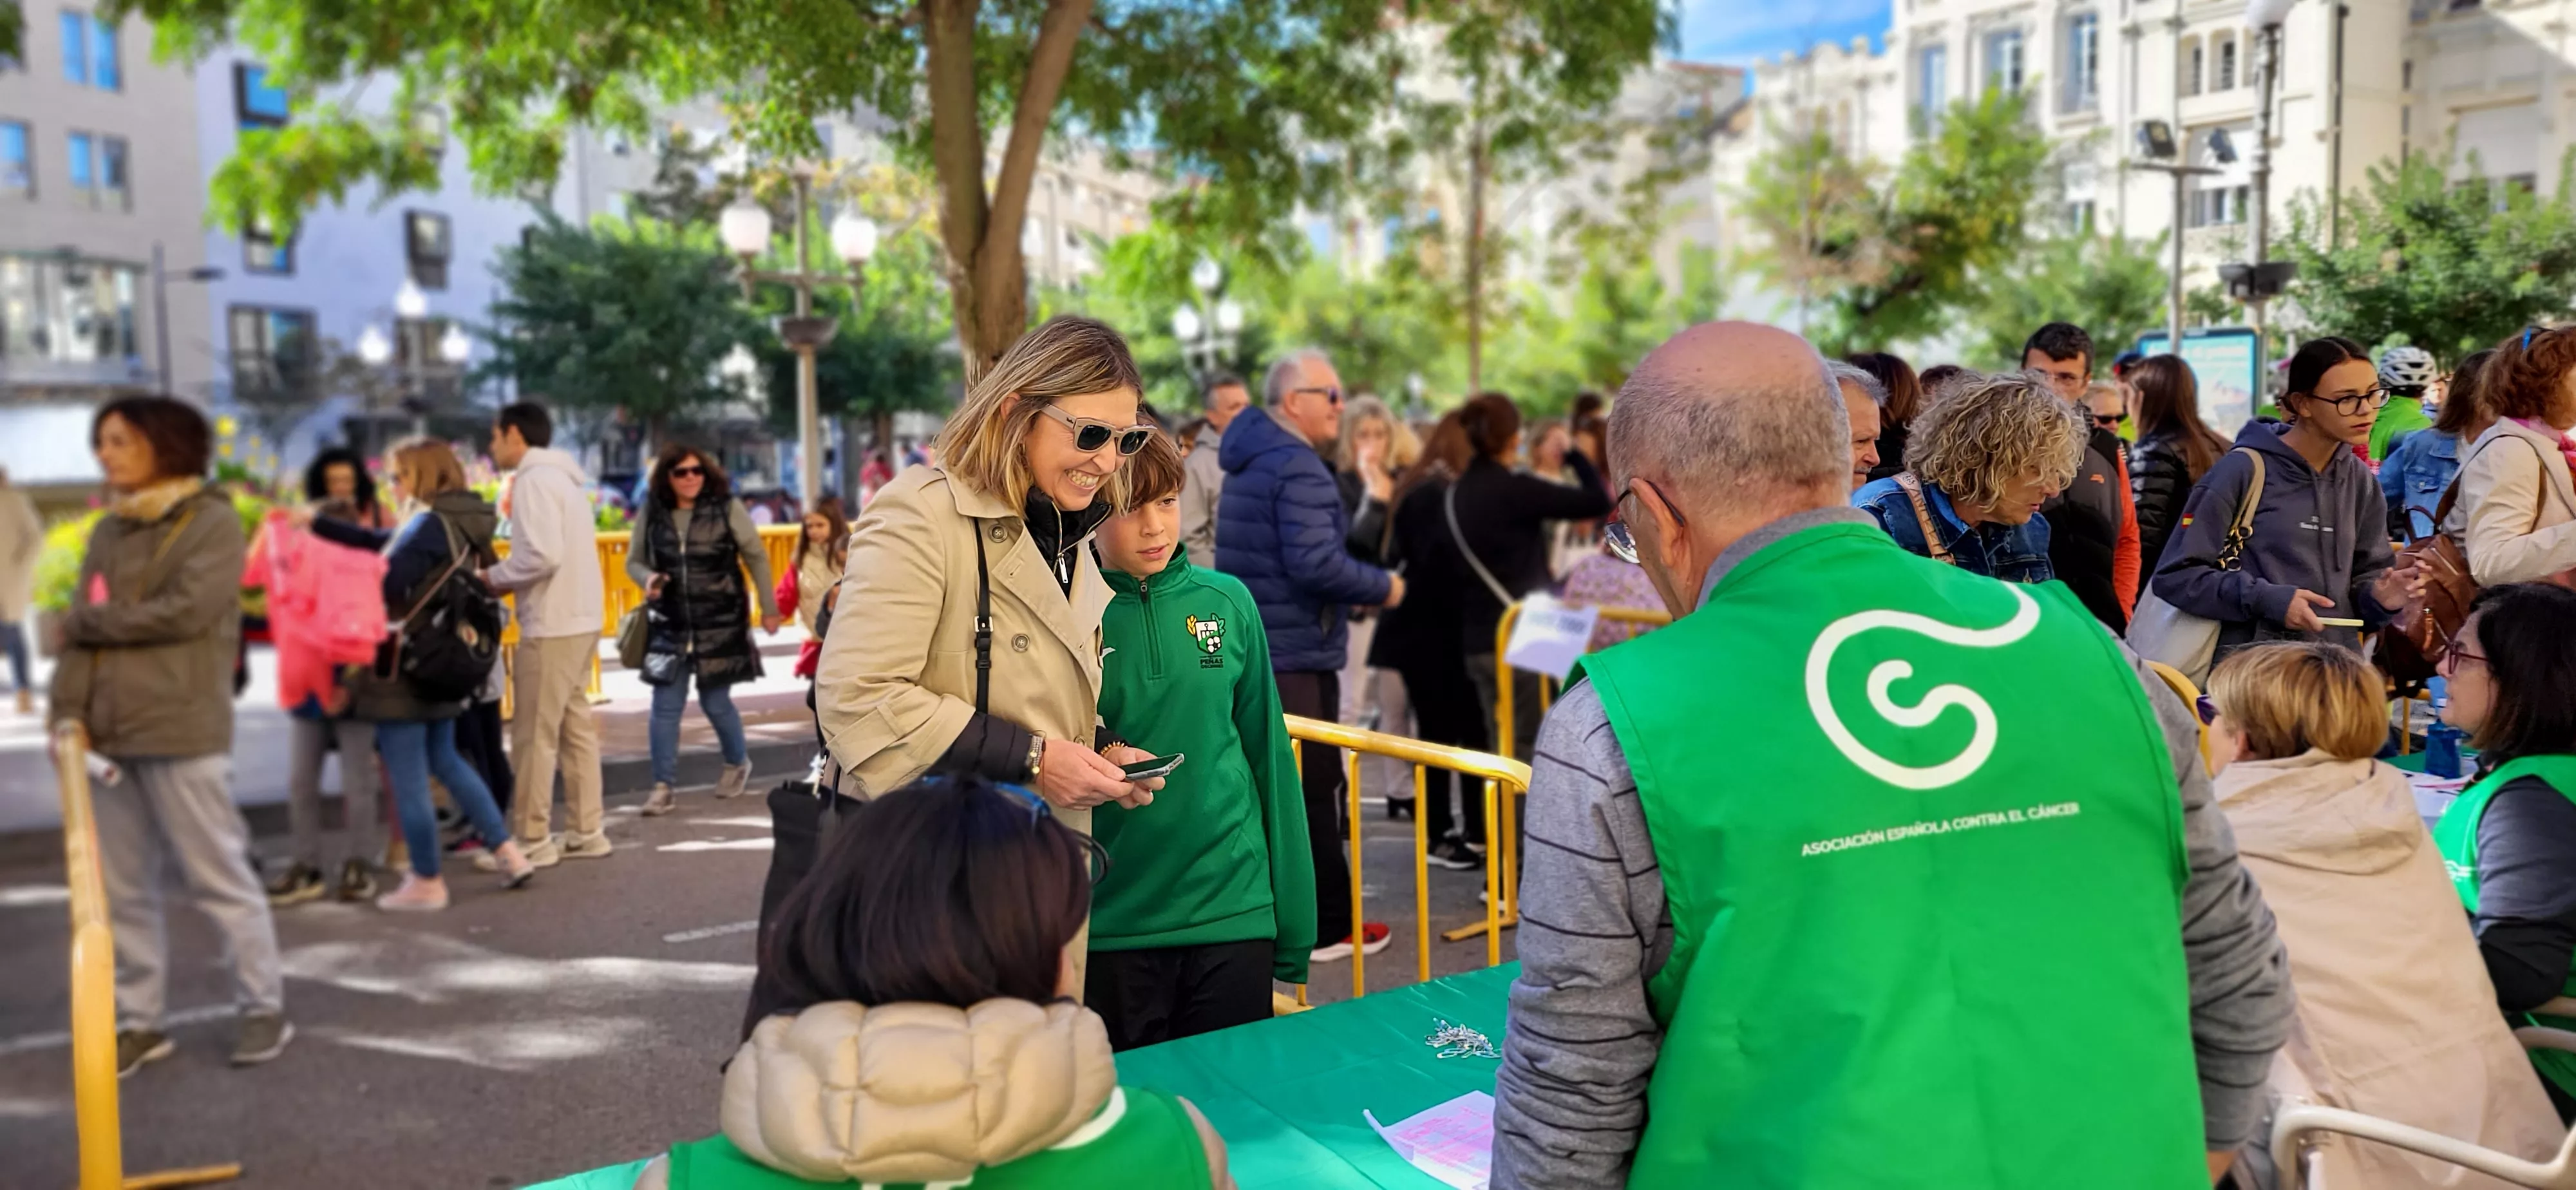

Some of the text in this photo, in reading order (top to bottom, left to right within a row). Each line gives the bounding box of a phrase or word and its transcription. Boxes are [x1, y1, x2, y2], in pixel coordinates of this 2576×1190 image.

[1801, 802, 2081, 857] ASOCIACIÓN ESPAÑOLA CONTRA EL CÁNCER
